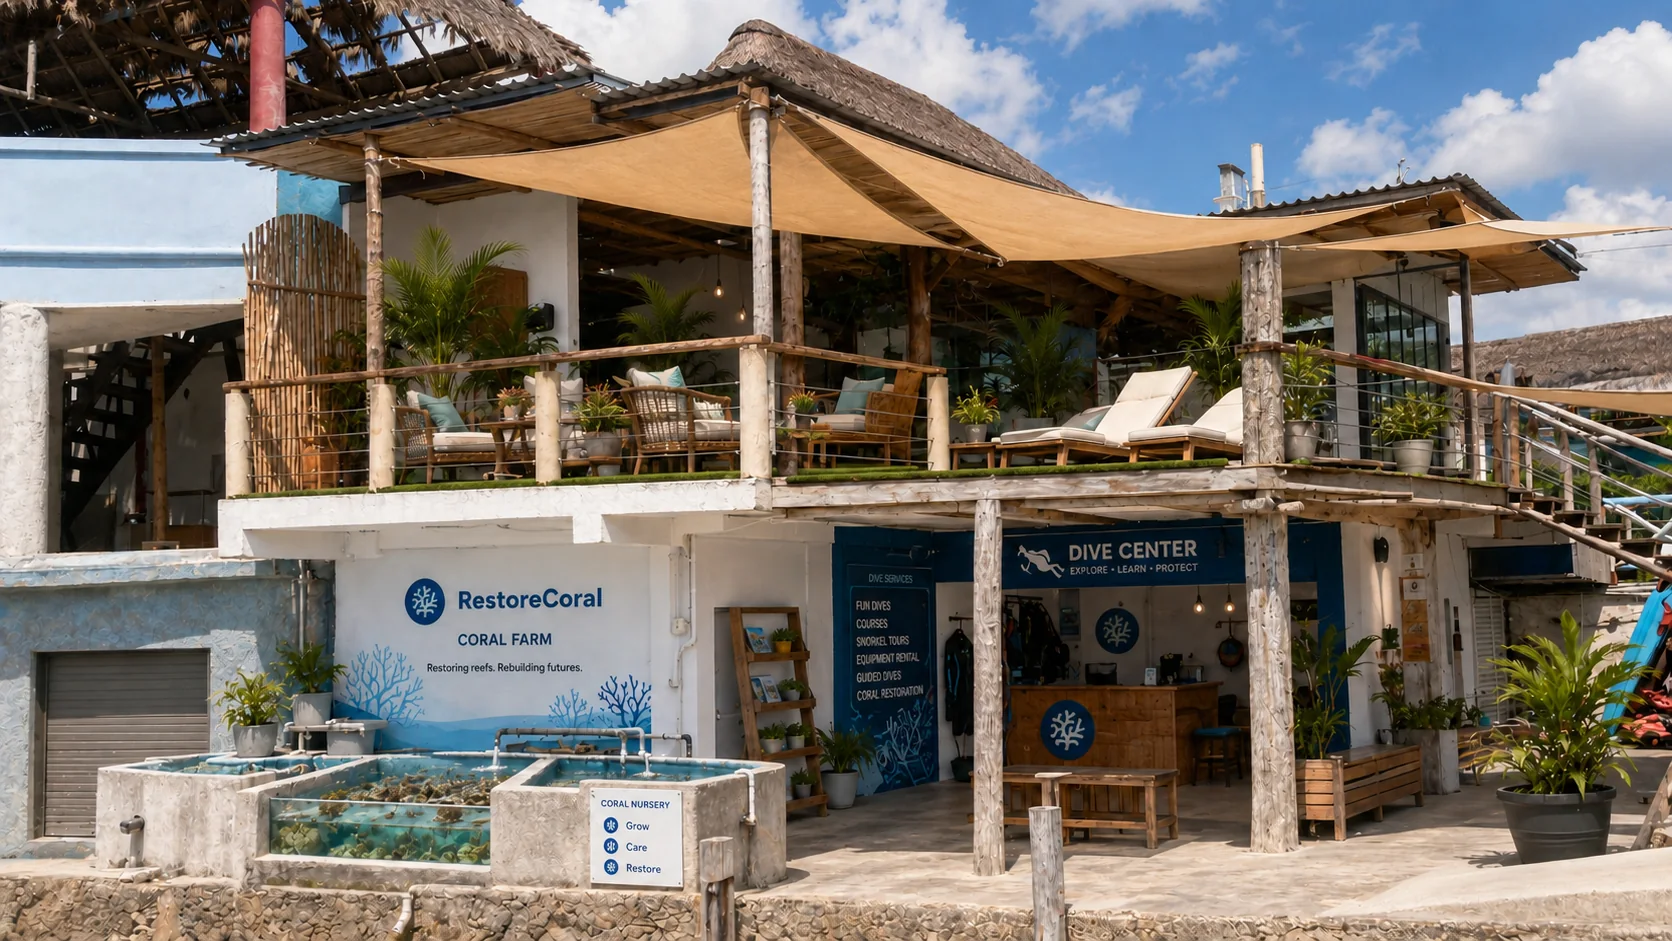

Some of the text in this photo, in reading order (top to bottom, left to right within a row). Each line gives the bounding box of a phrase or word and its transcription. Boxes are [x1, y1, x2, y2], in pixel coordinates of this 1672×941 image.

[1069, 540, 1198, 561] DIVE CENTER
[1070, 563, 1198, 575] EXPLORE LEARN PROTECT
[868, 574, 913, 584] DIVE SERVICES
[458, 588, 603, 610] RestoreCoral
[856, 600, 891, 611] FUN DIVES
[856, 618, 888, 629] COURSES
[458, 633, 552, 646] CORAL FARM
[856, 636, 910, 647] SNORKEL TOURS
[856, 653, 920, 665] EQUIPMENT RENTAL
[427, 663, 582, 674] Restoring reefs. Rebuilding futures.
[857, 670, 902, 683] GUIDED DIVES
[857, 685, 923, 701] CORAL RESTORATION
[601, 800, 670, 809] CORAL NURSERY
[626, 821, 649, 830] Grow
[626, 842, 647, 852] Care
[626, 864, 661, 873] Restore
